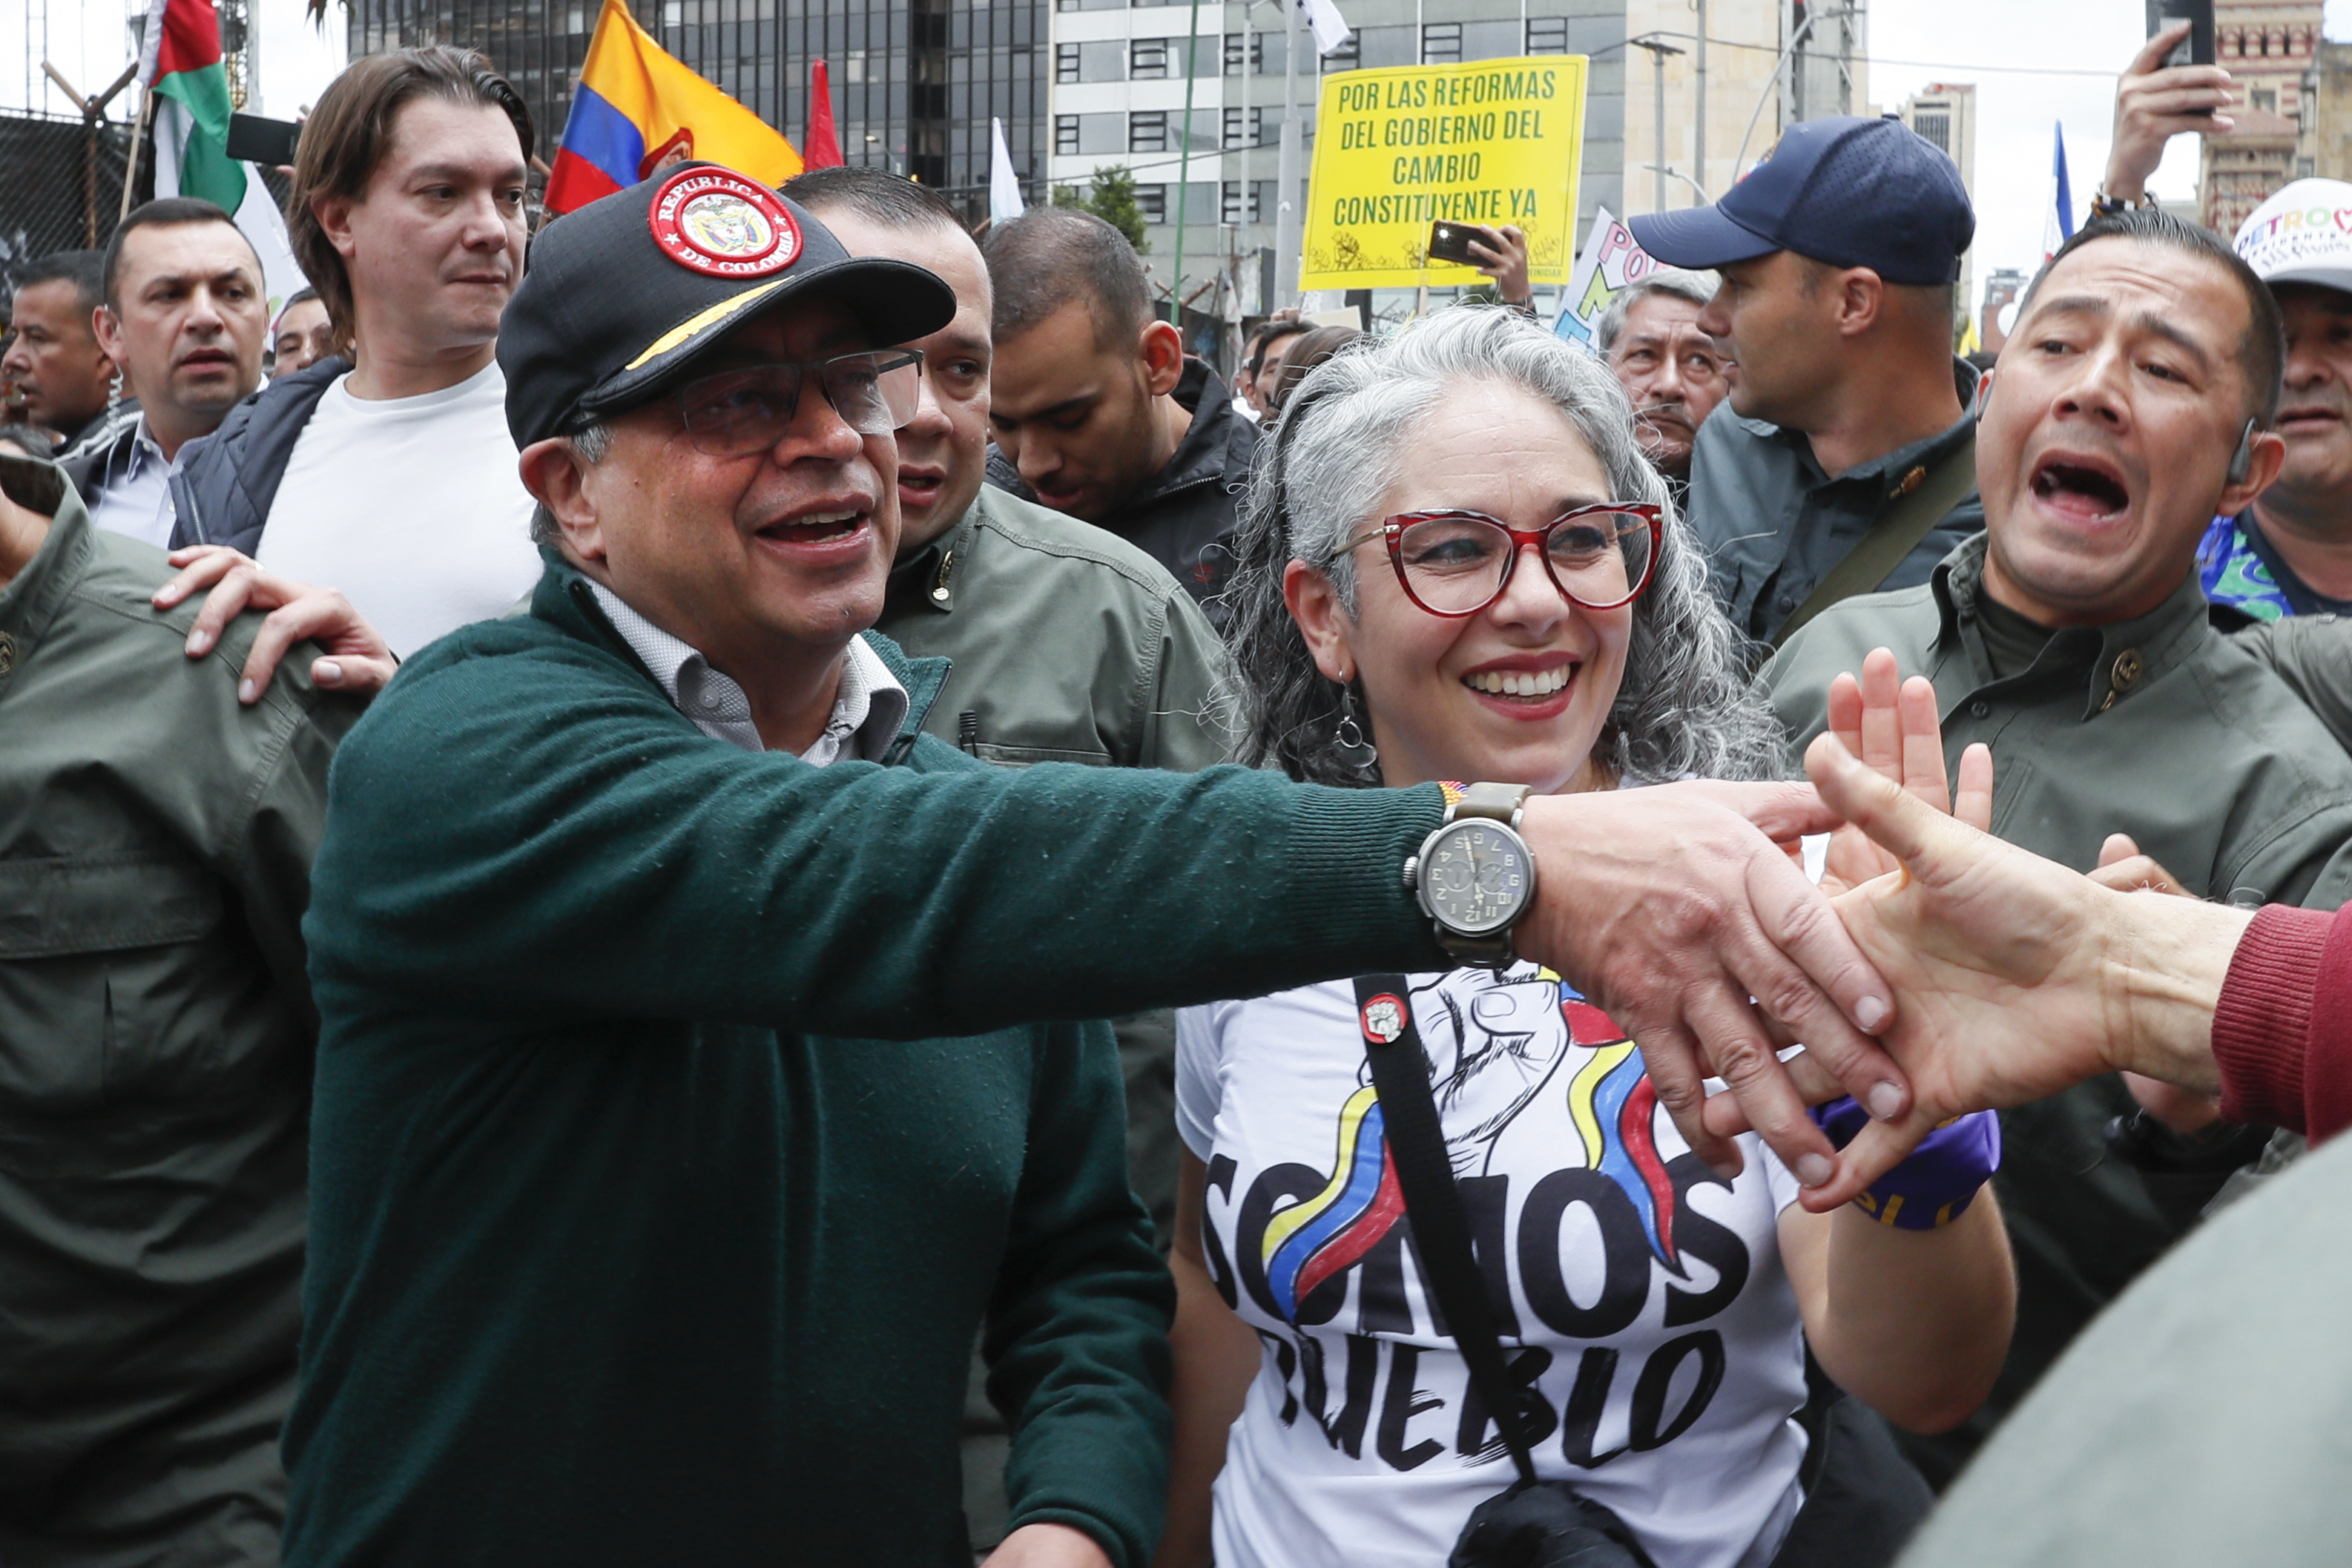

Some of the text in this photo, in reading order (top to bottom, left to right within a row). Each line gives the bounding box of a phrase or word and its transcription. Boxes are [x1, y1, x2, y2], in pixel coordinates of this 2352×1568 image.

[1339, 70, 1556, 113] POR LAS REFORMAS
[1341, 110, 1544, 150] DEL GOBIERNO DEL
[1393, 152, 1481, 185] CAMBIO
[658, 176, 764, 222] REPUBLICA
[1334, 189, 1537, 226] CONSTITUYENTE YA
[678, 230, 794, 273] DE COLOMBIA
[1597, 221, 1672, 285] PO
[2237, 208, 2331, 256] PETRO
[1526, 268, 1562, 277] EINICIAR
